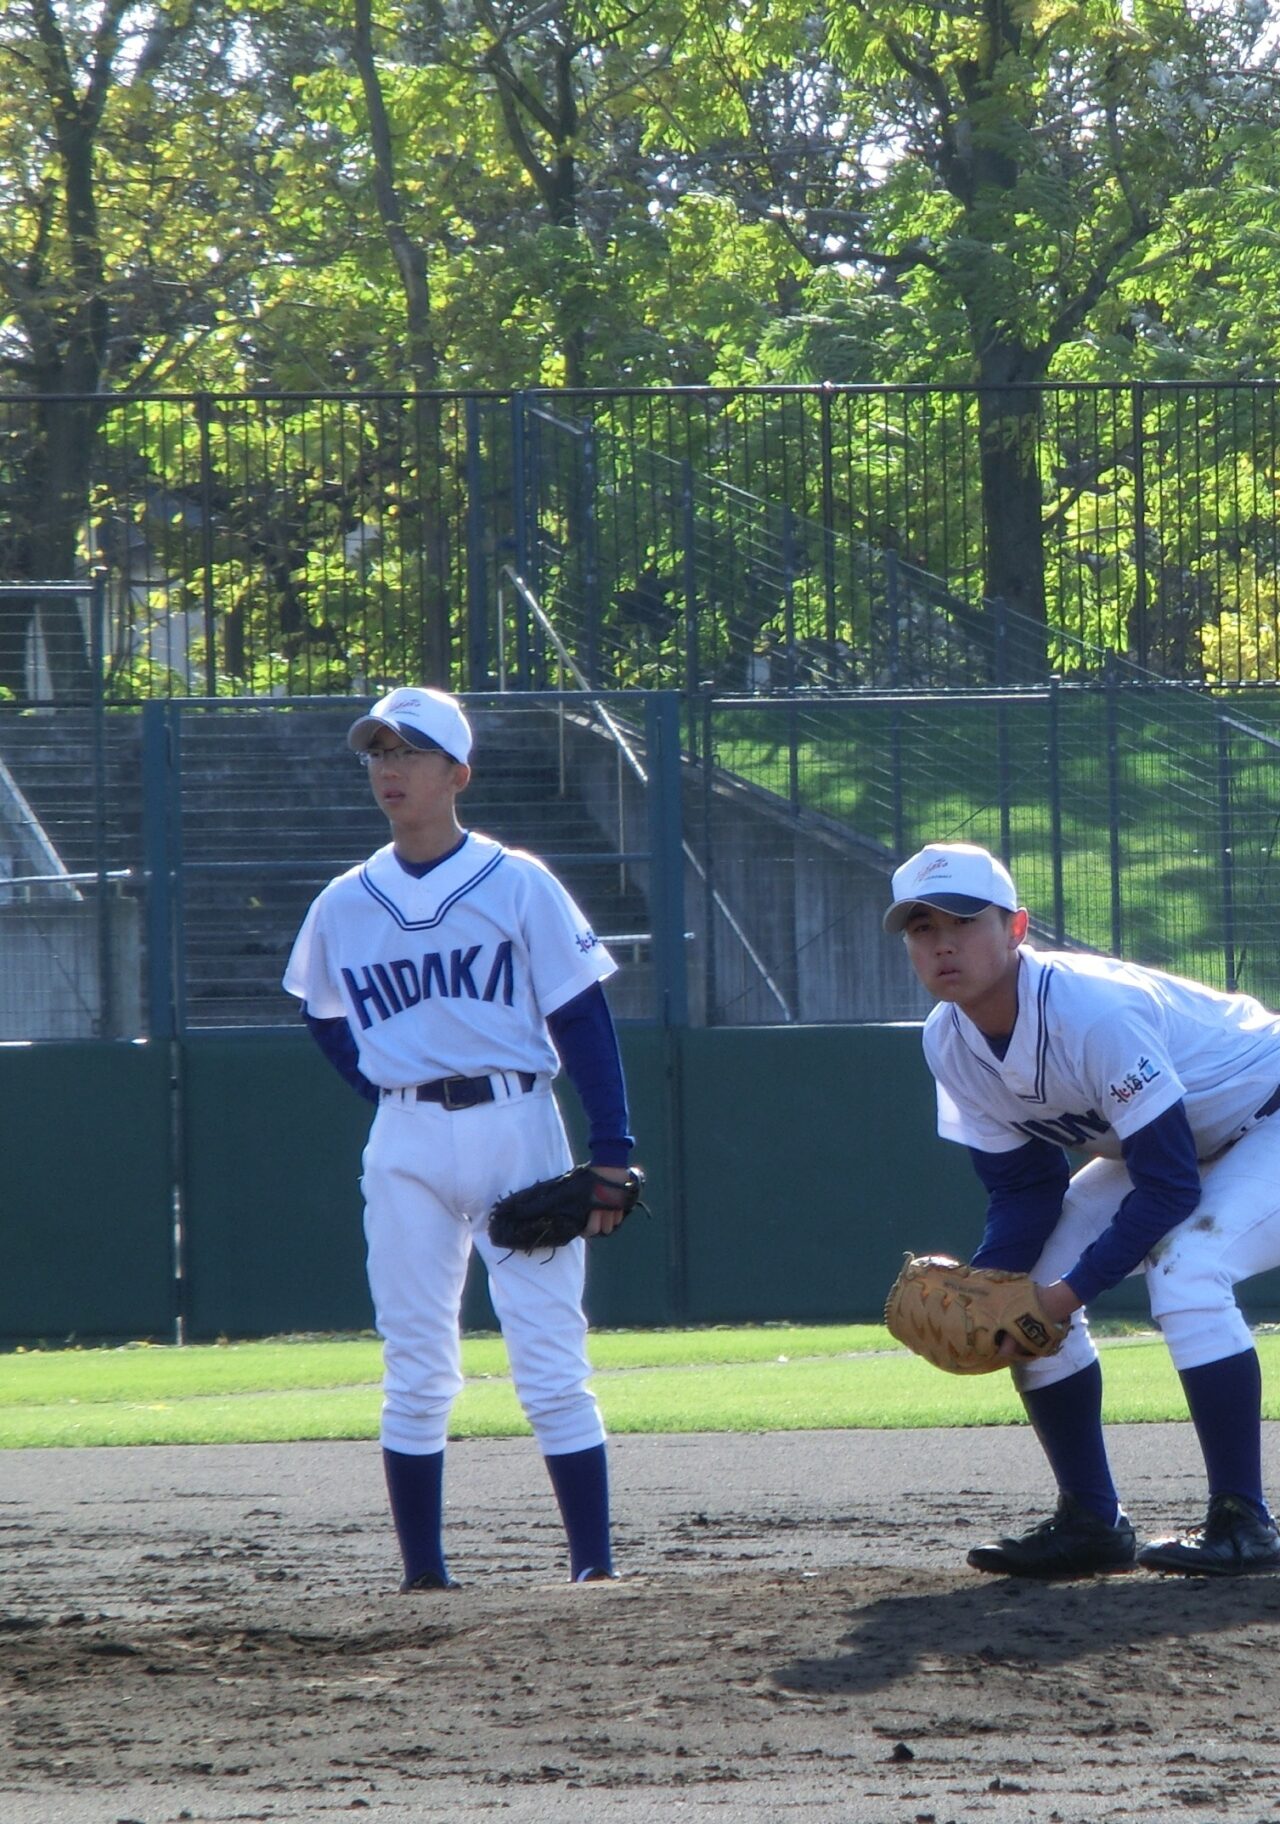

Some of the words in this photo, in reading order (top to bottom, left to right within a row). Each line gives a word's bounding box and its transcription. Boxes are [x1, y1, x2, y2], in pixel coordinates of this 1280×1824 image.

[341, 940, 514, 1030] HIDAKA
[1110, 1056, 1161, 1103] 北海道
